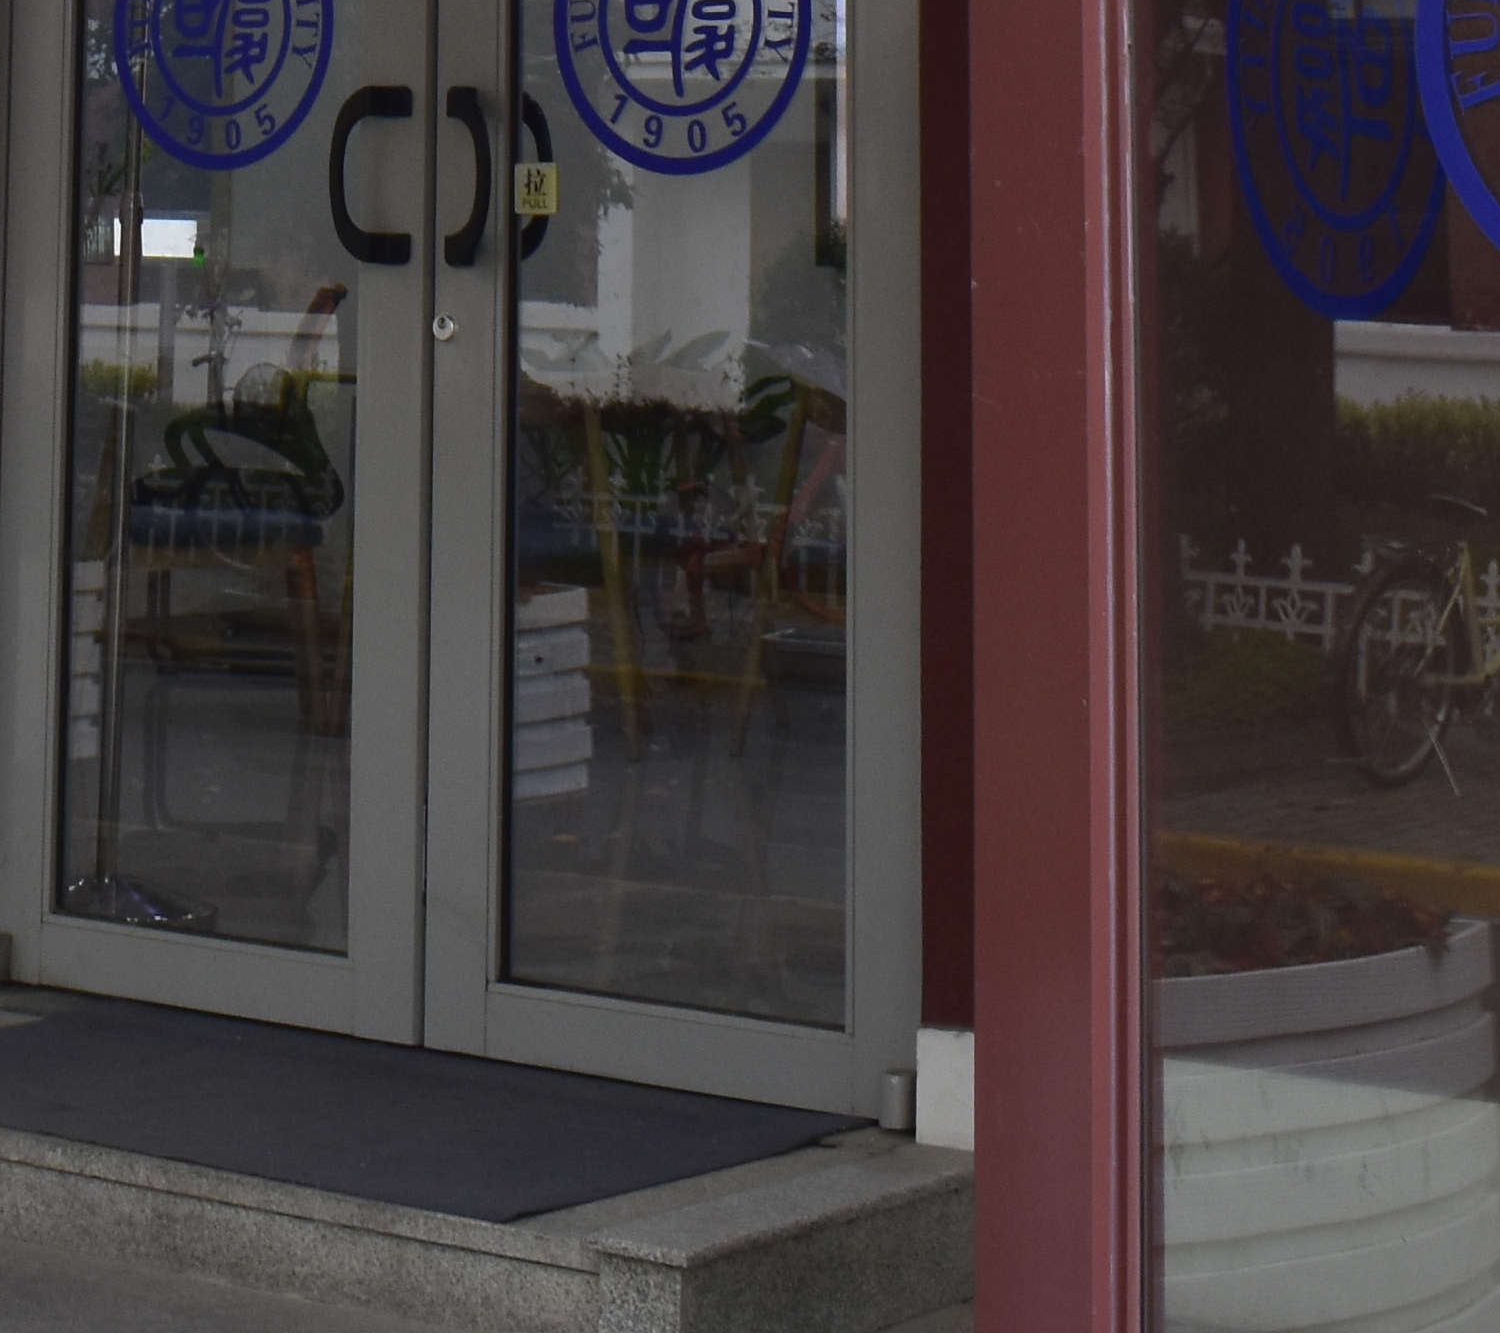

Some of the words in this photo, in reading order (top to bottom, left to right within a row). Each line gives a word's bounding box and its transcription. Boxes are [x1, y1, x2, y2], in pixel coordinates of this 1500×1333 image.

[608, 92, 748, 154] 1905
[524, 168, 547, 197] 拉
[522, 196, 549, 210] PULL
